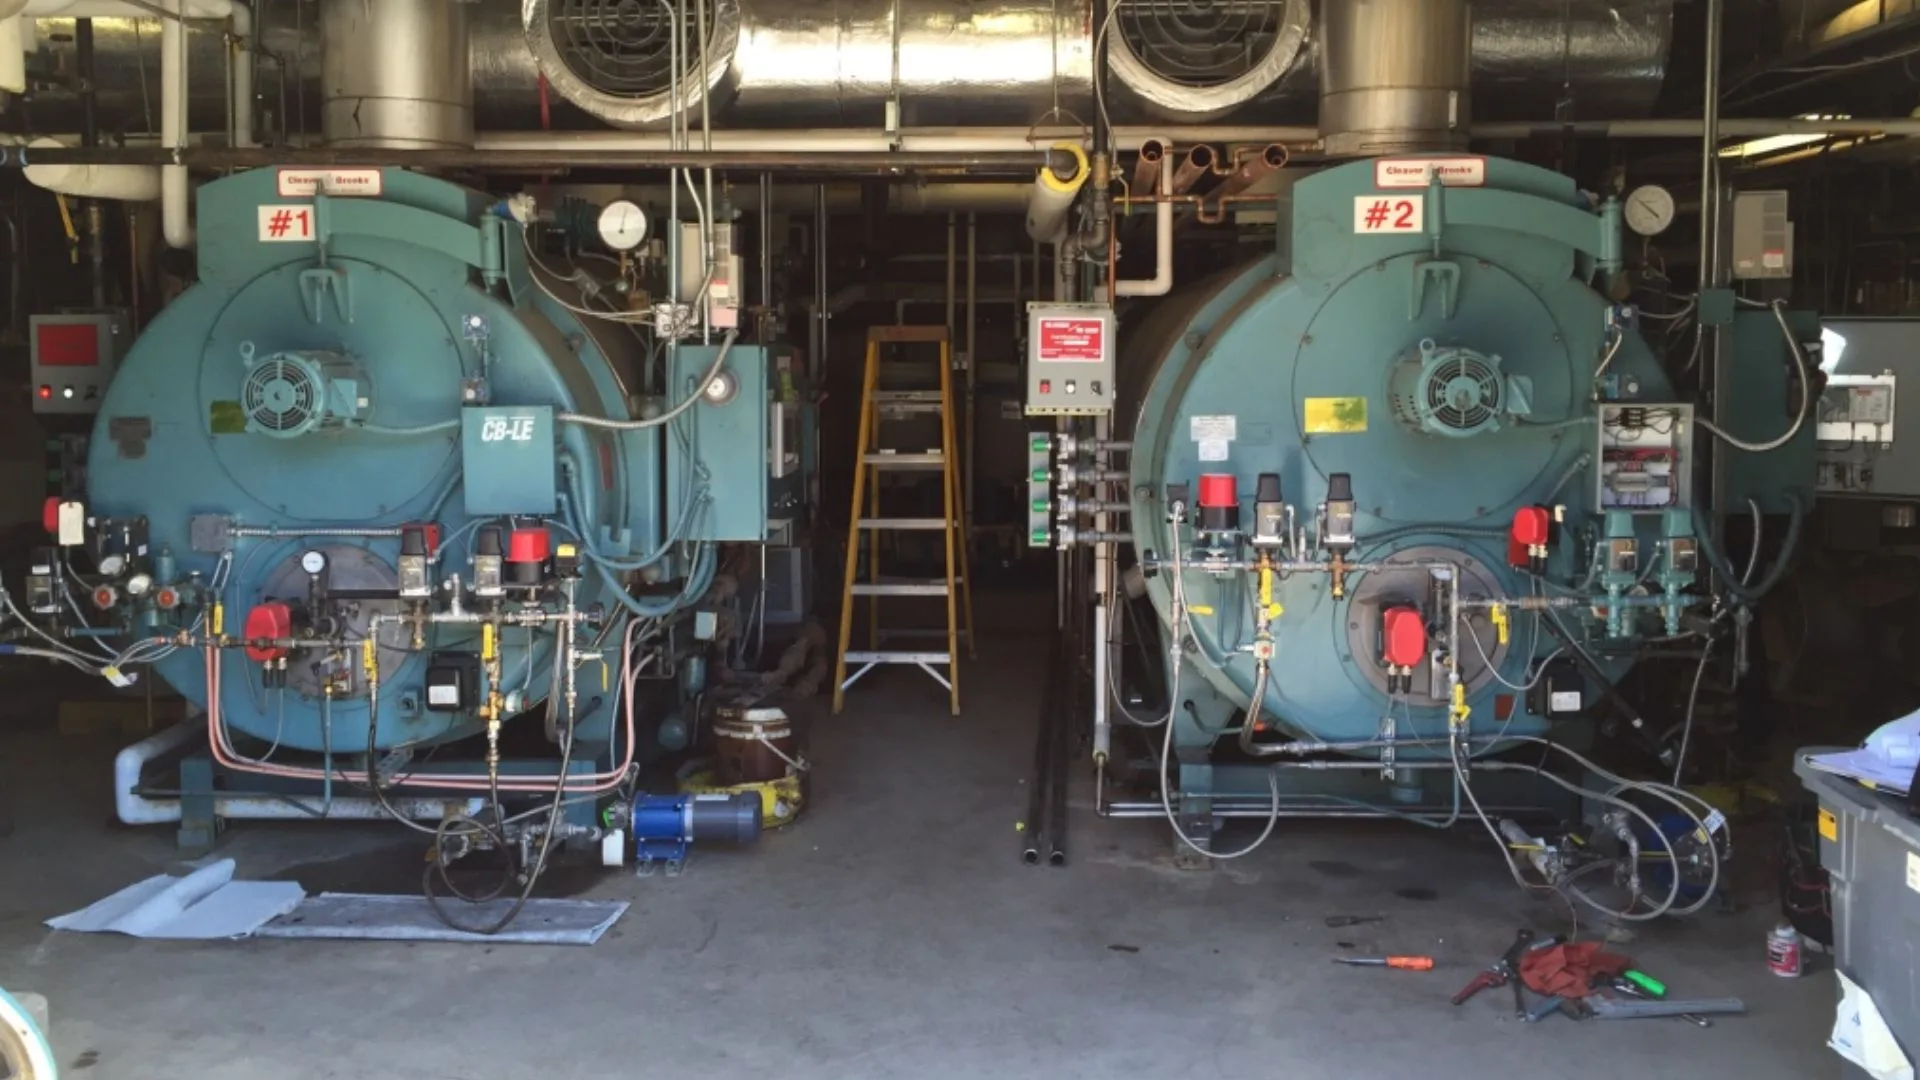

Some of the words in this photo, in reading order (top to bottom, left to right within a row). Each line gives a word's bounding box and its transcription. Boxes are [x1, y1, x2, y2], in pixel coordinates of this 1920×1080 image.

[335, 175, 370, 185] Brooks
[268, 209, 309, 238] #1
[1364, 200, 1414, 229] #2
[481, 418, 535, 442] CB-LE
